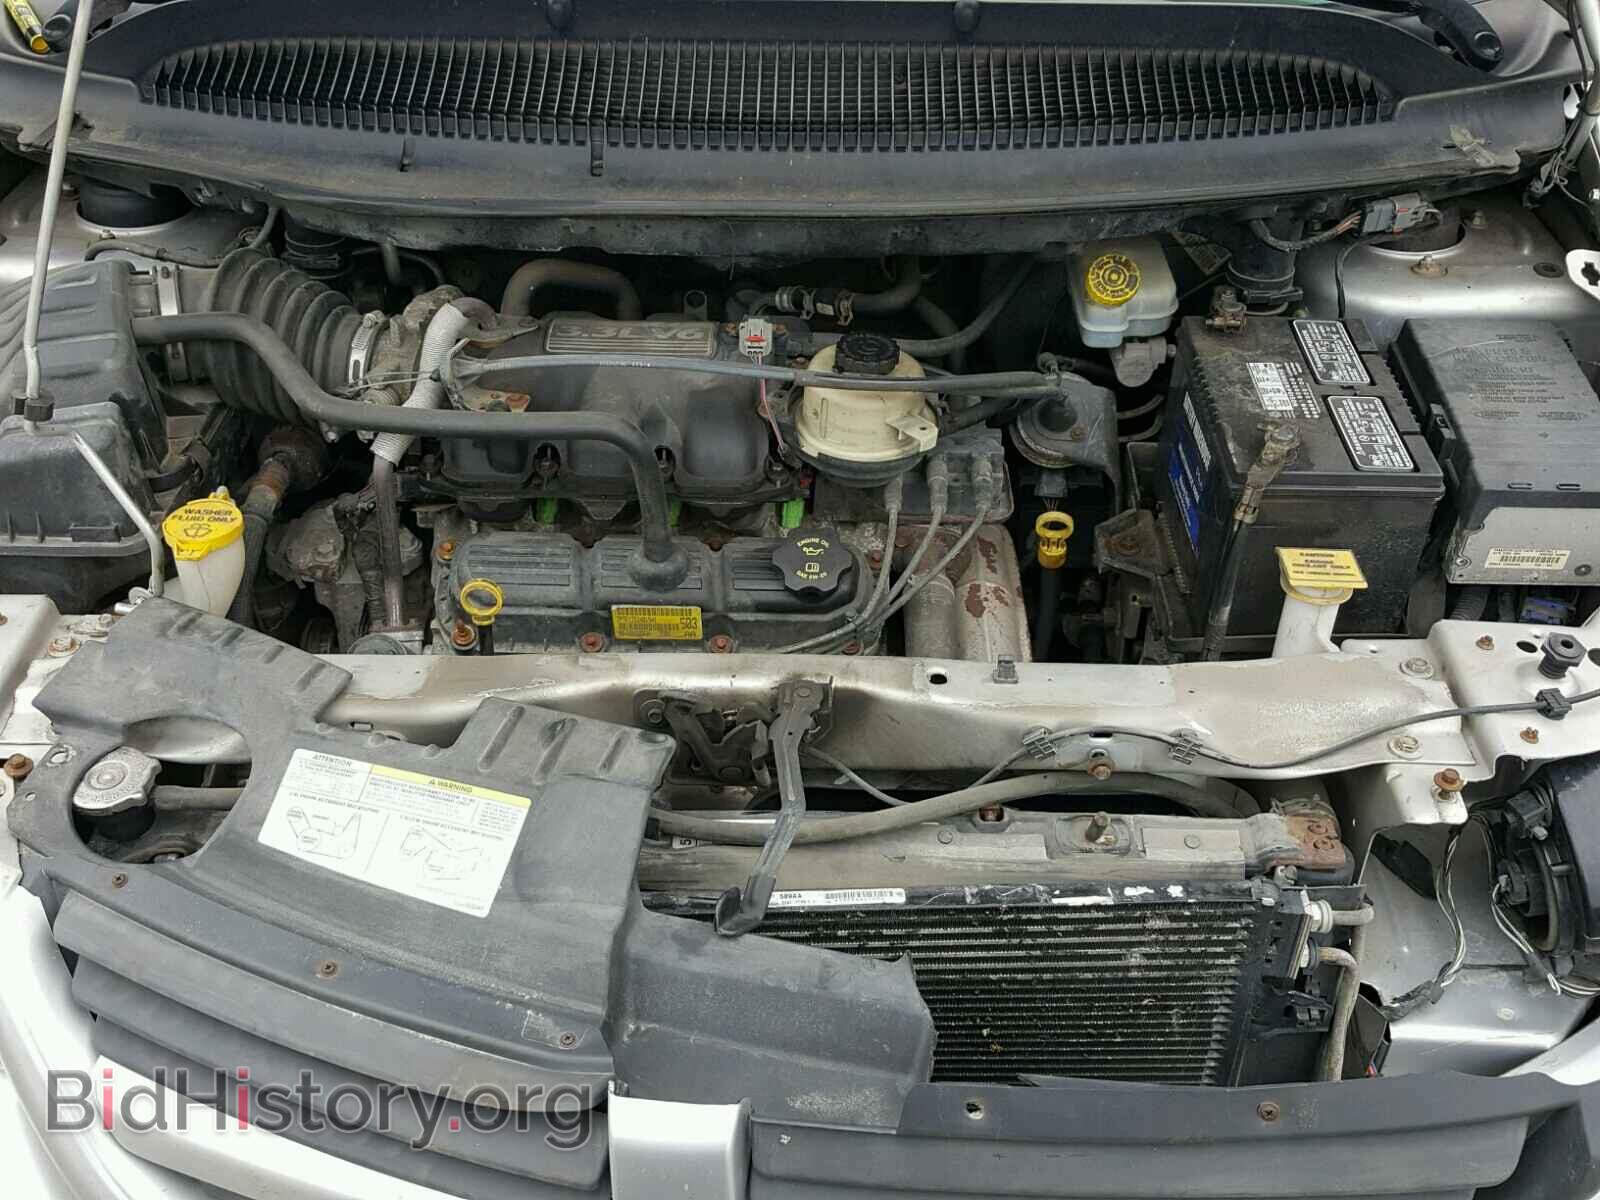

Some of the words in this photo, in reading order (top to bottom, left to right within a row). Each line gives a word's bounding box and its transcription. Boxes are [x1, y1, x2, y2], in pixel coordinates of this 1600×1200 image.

[556, 325, 638, 338] 3.3L
[650, 325, 705, 339] V6
[171, 513, 206, 522] FLUID
[207, 514, 238, 524] ONLY
[183, 508, 233, 517] WASHER
[796, 537, 821, 547] ENGINE
[820, 538, 831, 549] OIL
[679, 616, 698, 630] 503
[312, 753, 353, 768] ATTENTION
[437, 779, 473, 794] WARNING
